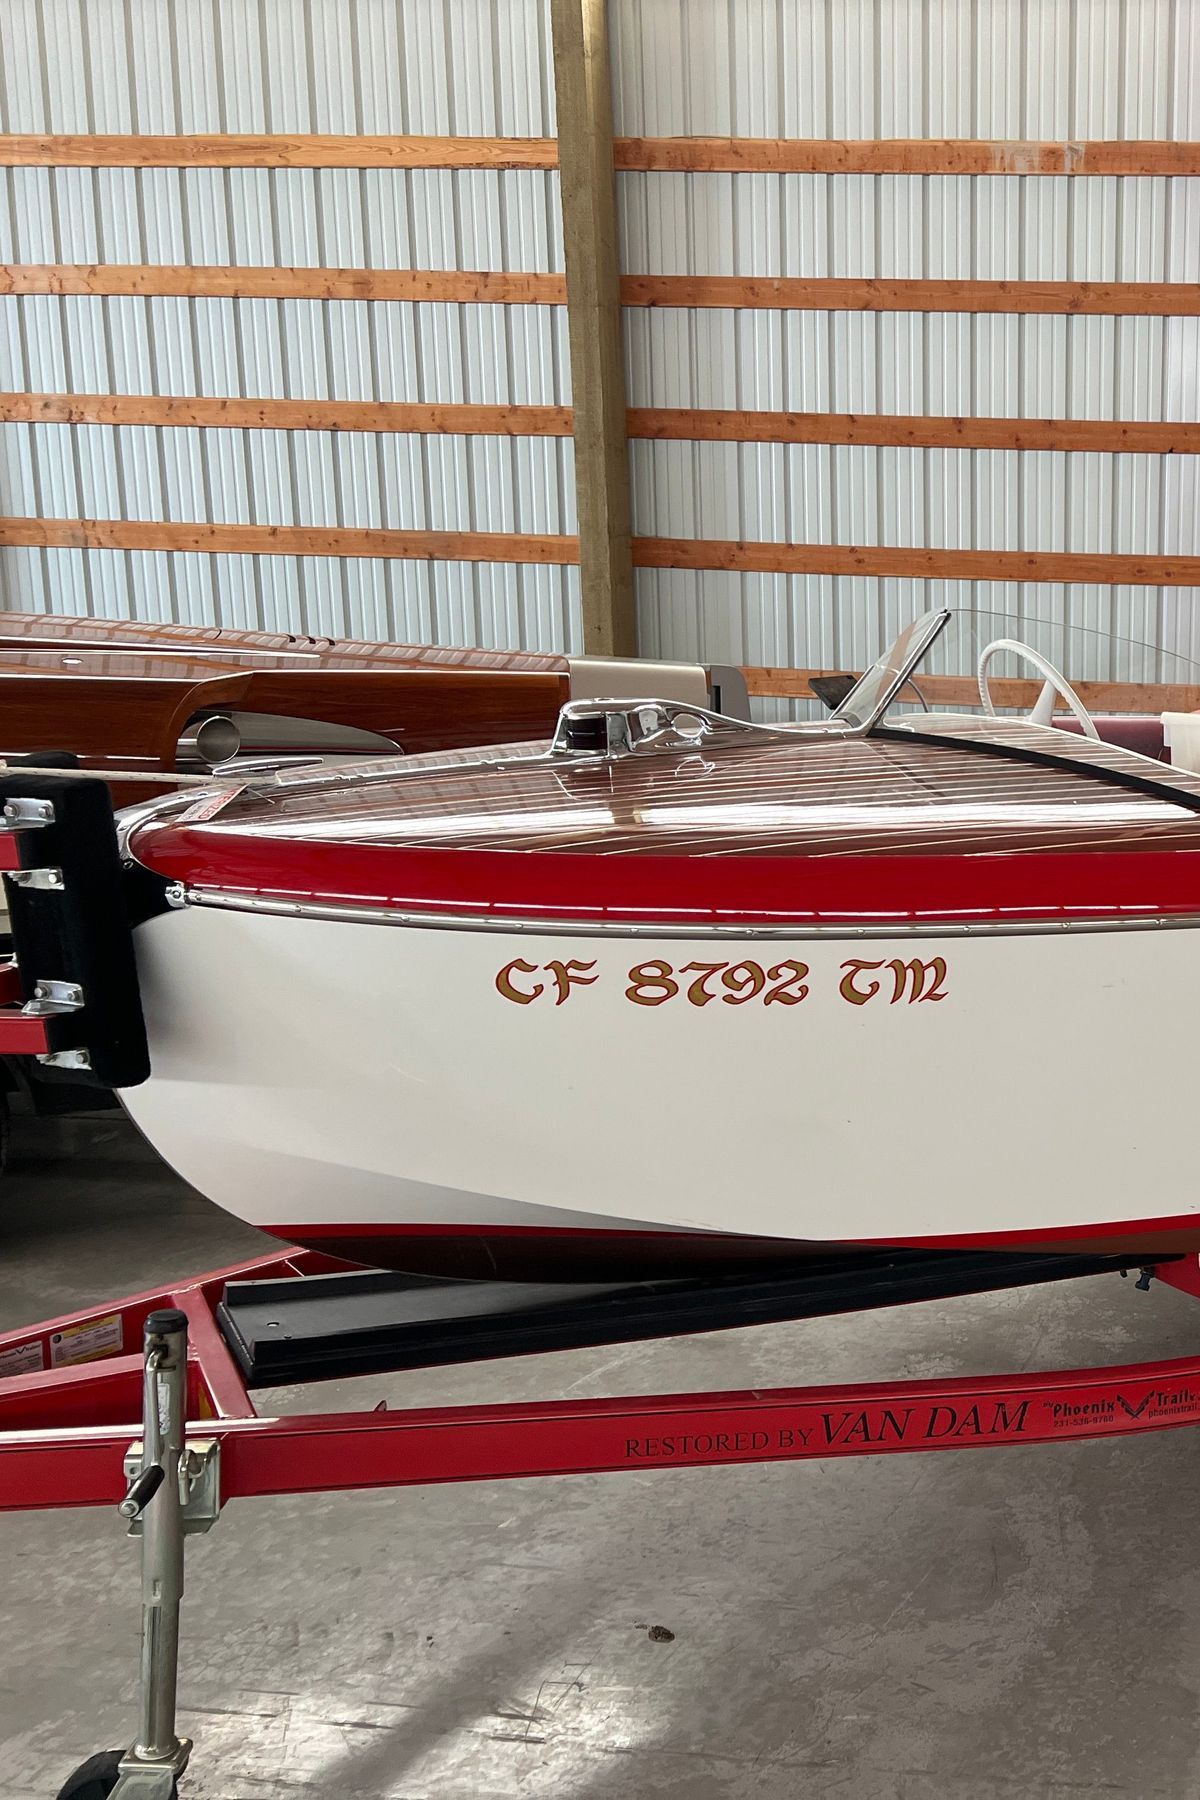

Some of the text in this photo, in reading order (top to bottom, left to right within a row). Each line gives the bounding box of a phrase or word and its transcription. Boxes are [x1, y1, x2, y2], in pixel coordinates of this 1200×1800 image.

[495, 955, 949, 1008] CF 8792 TM
[624, 1400, 1033, 1458] RESTORED BY VAN DAM
[1053, 1399, 1115, 1418] Phoenix
